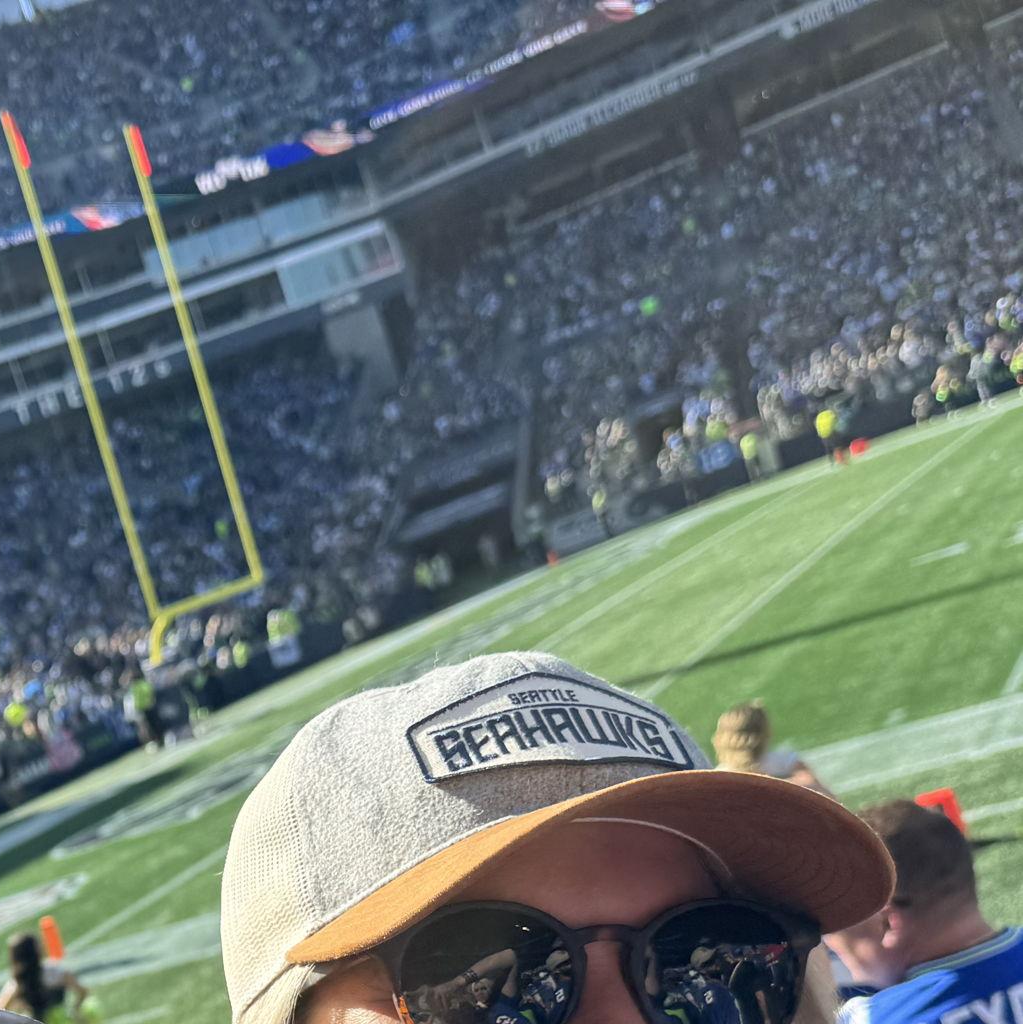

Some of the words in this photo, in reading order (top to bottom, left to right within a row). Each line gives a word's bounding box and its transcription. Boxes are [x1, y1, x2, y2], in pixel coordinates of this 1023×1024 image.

[12, 380, 83, 426] THE
[507, 688, 580, 706] SEATTLE
[433, 706, 675, 773] SEAHAWKS
